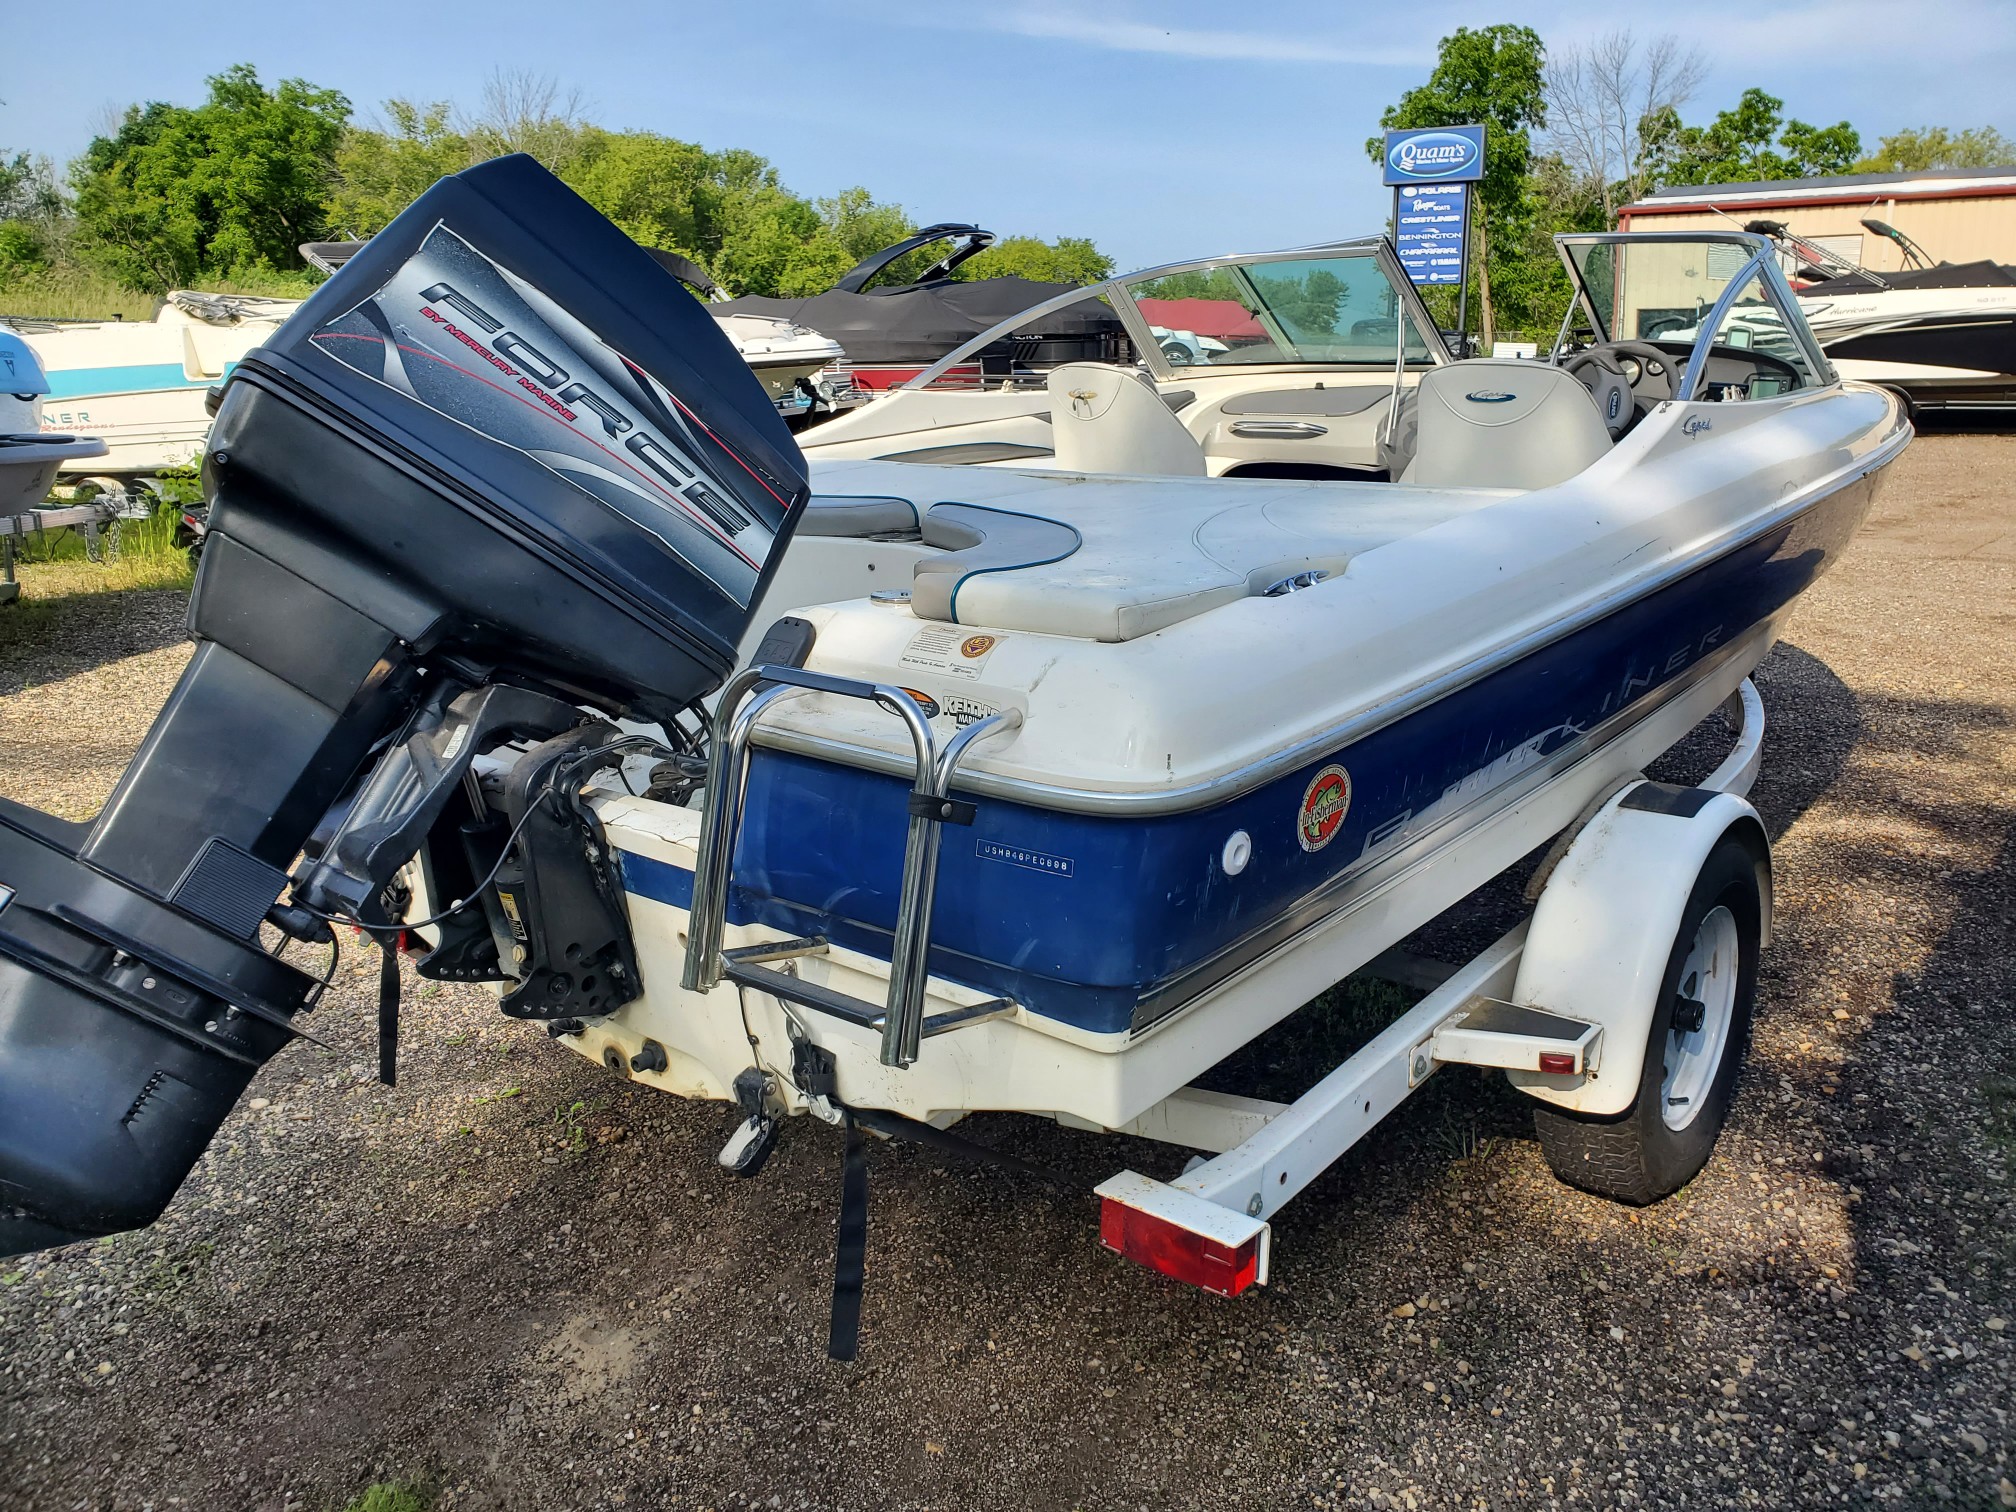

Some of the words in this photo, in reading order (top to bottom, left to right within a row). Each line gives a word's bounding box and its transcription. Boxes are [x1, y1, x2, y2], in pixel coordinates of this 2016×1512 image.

[1401, 143, 1466, 162] Quam's
[1419, 186, 1461, 195] POLARIS
[1401, 215, 1460, 224] CRESTLINER
[1399, 232, 1461, 240] BENNINGTON
[419, 306, 448, 324] BY
[443, 322, 520, 378] MERCURY
[516, 376, 578, 422] MARINE
[419, 282, 751, 539] FORCE
